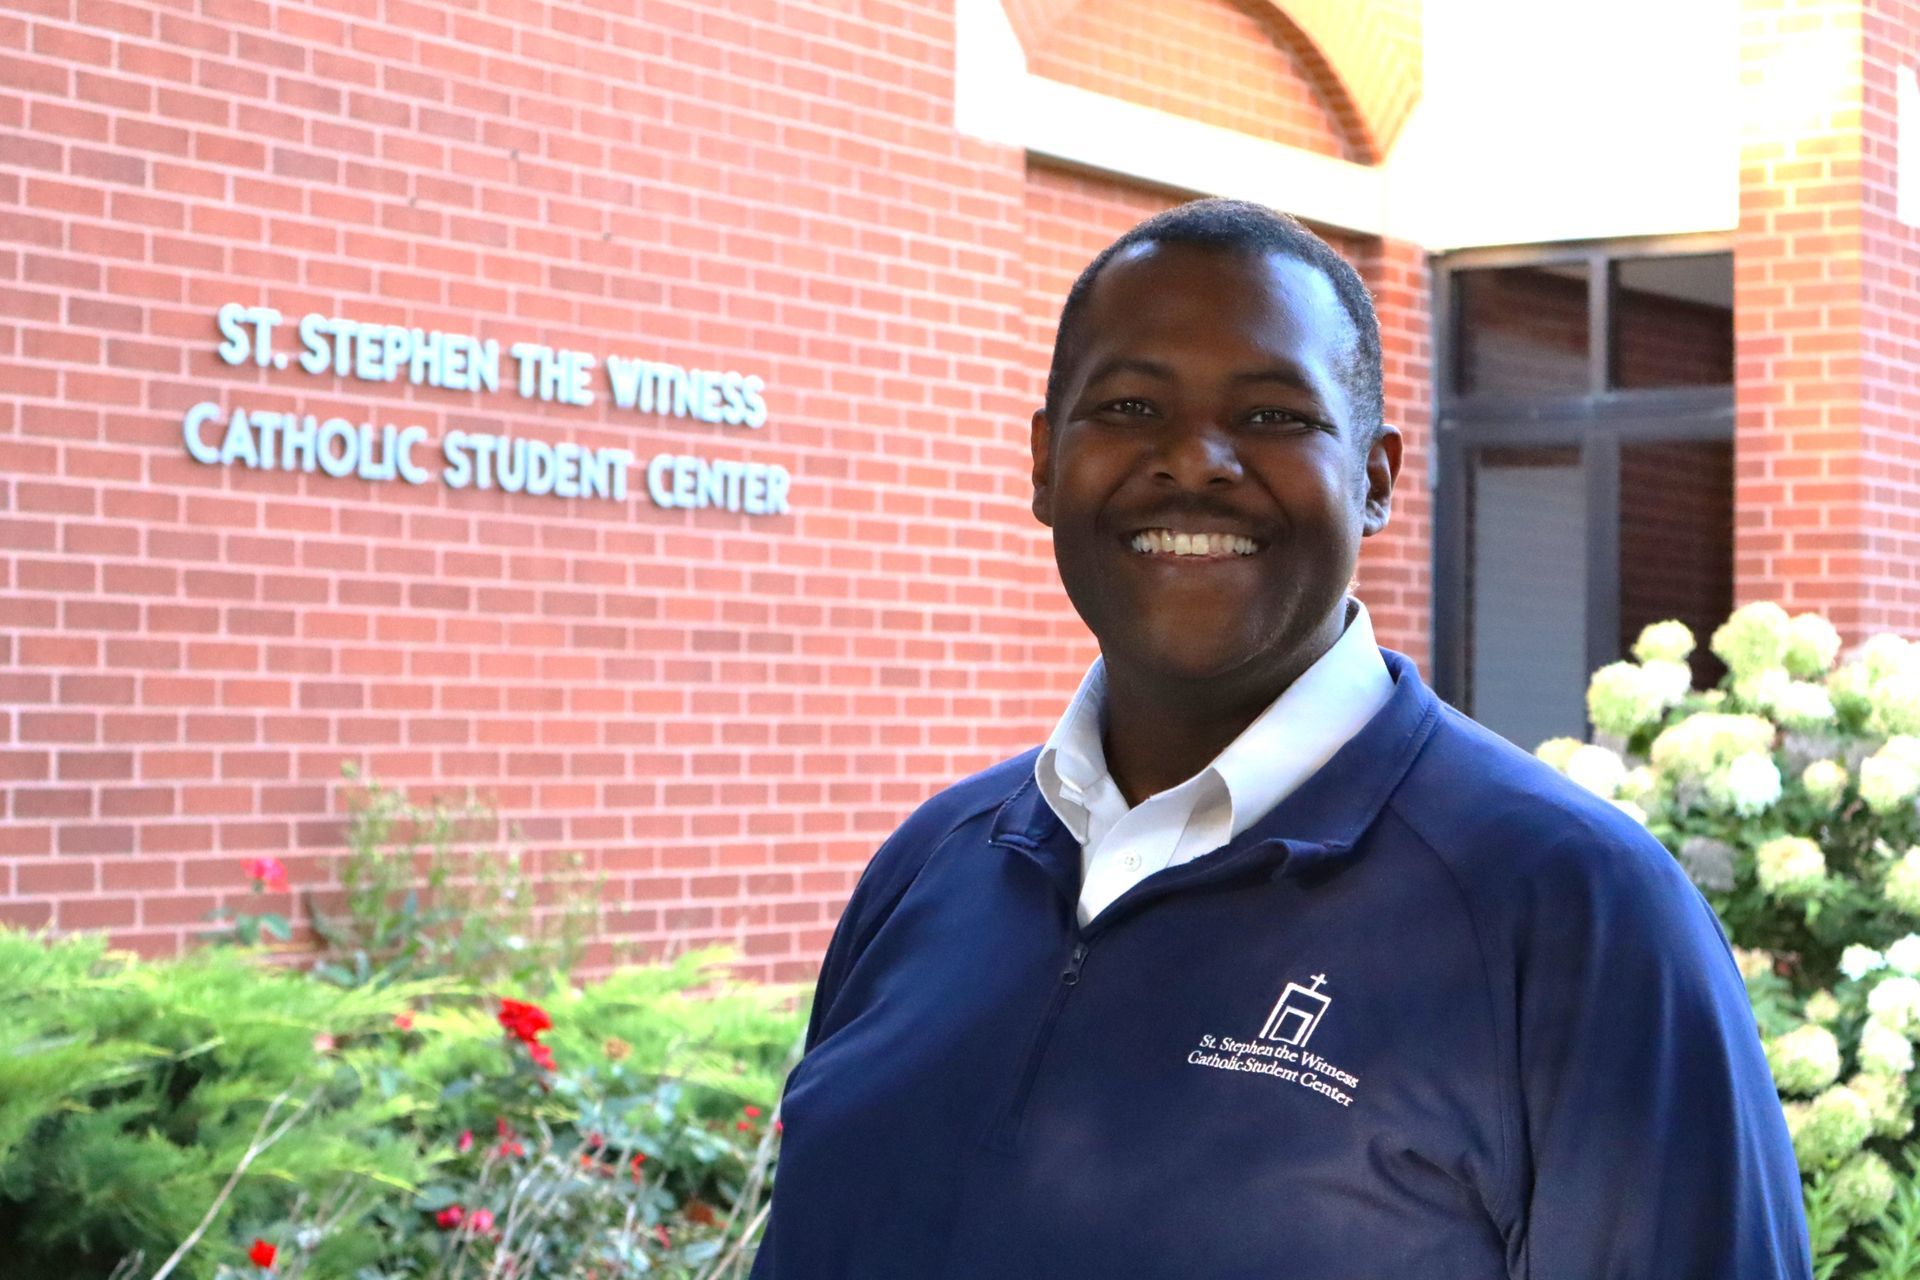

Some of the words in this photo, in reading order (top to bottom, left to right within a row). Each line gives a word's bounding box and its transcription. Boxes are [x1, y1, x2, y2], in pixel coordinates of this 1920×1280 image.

[217, 303, 288, 369] ST.
[299, 313, 500, 393] STEPHEN
[511, 342, 596, 406] THE
[606, 354, 768, 429] WITNESS
[184, 402, 429, 485] CATHOLIC
[443, 430, 635, 502] STUDENT
[647, 453, 791, 515] CENTER
[1187, 1050, 1244, 1071] Catholic
[1242, 1057, 1299, 1082] Student
[1300, 1072, 1354, 1107] Center
[1199, 1034, 1216, 1049] St.
[1220, 1037, 1277, 1057] Stephen
[1274, 1044, 1299, 1062] the
[1301, 1051, 1360, 1089] Witness
